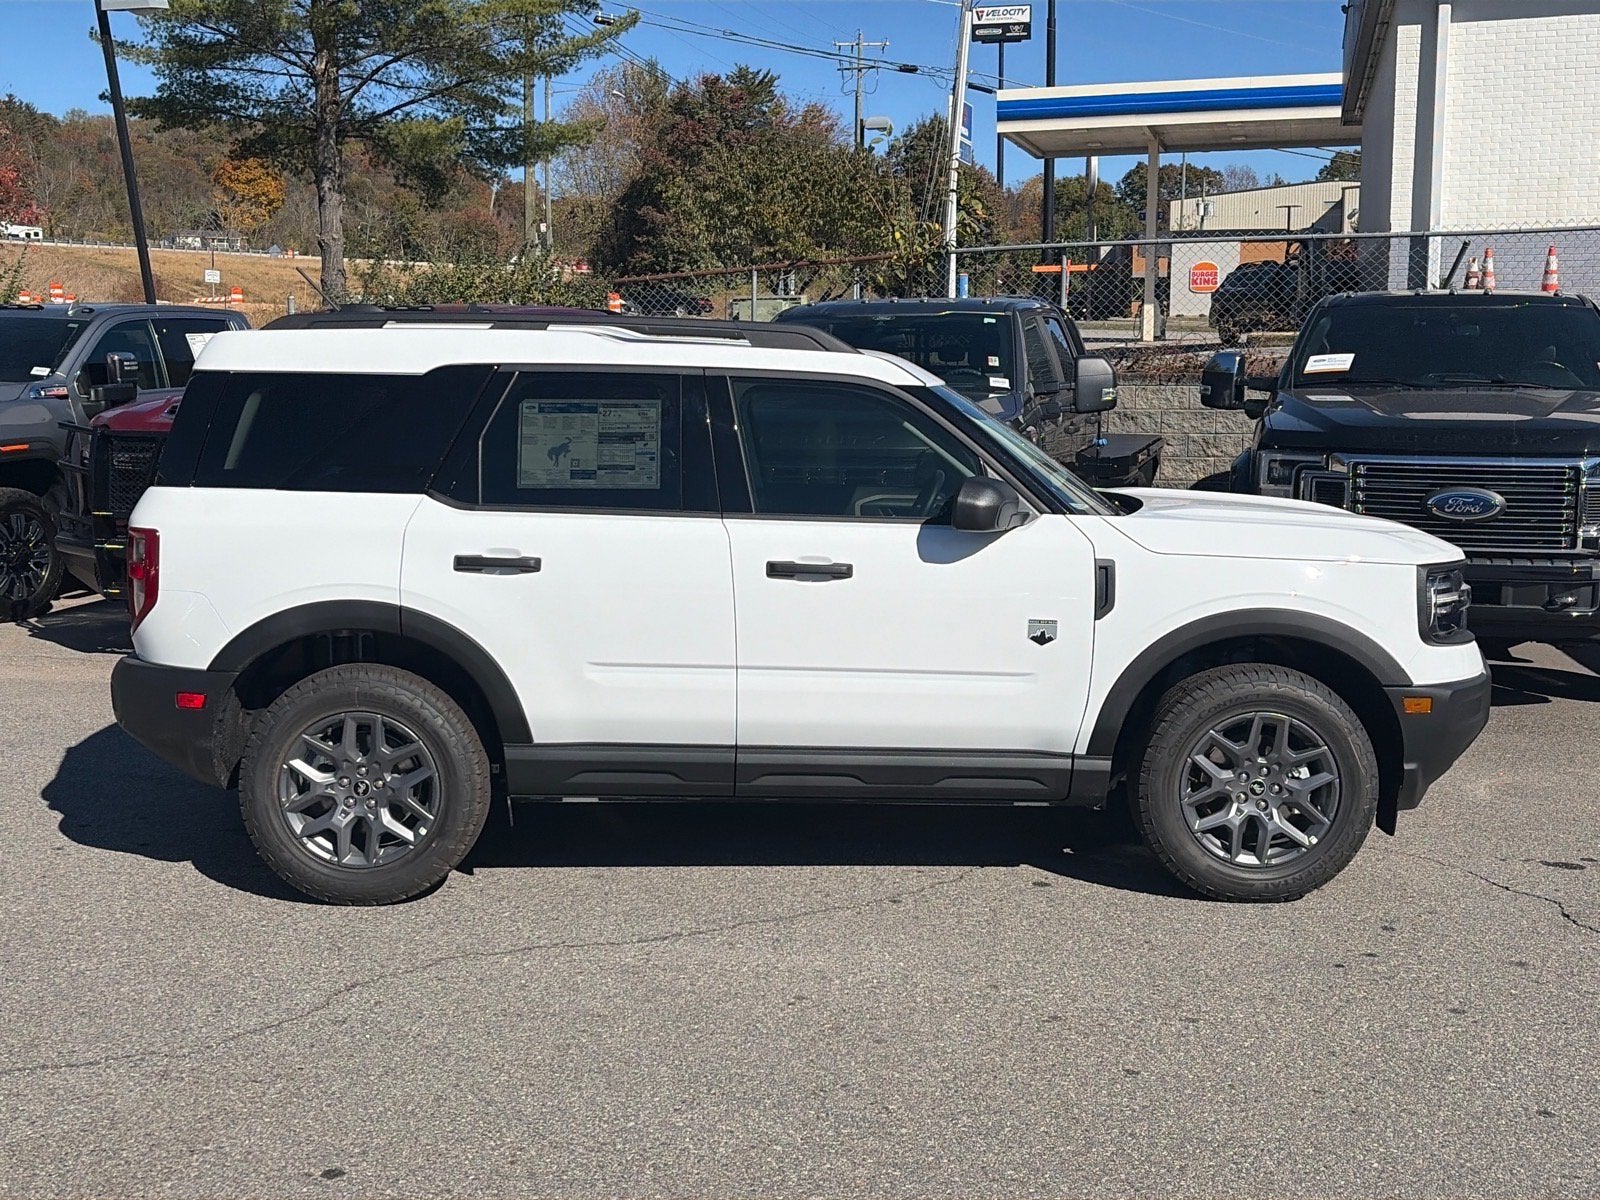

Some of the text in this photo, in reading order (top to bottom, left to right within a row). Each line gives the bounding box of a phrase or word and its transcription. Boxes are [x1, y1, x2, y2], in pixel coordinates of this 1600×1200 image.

[986, 8, 1028, 17] VELOCITY
[1191, 277, 1218, 286] KING
[1444, 497, 1484, 513] Ford
